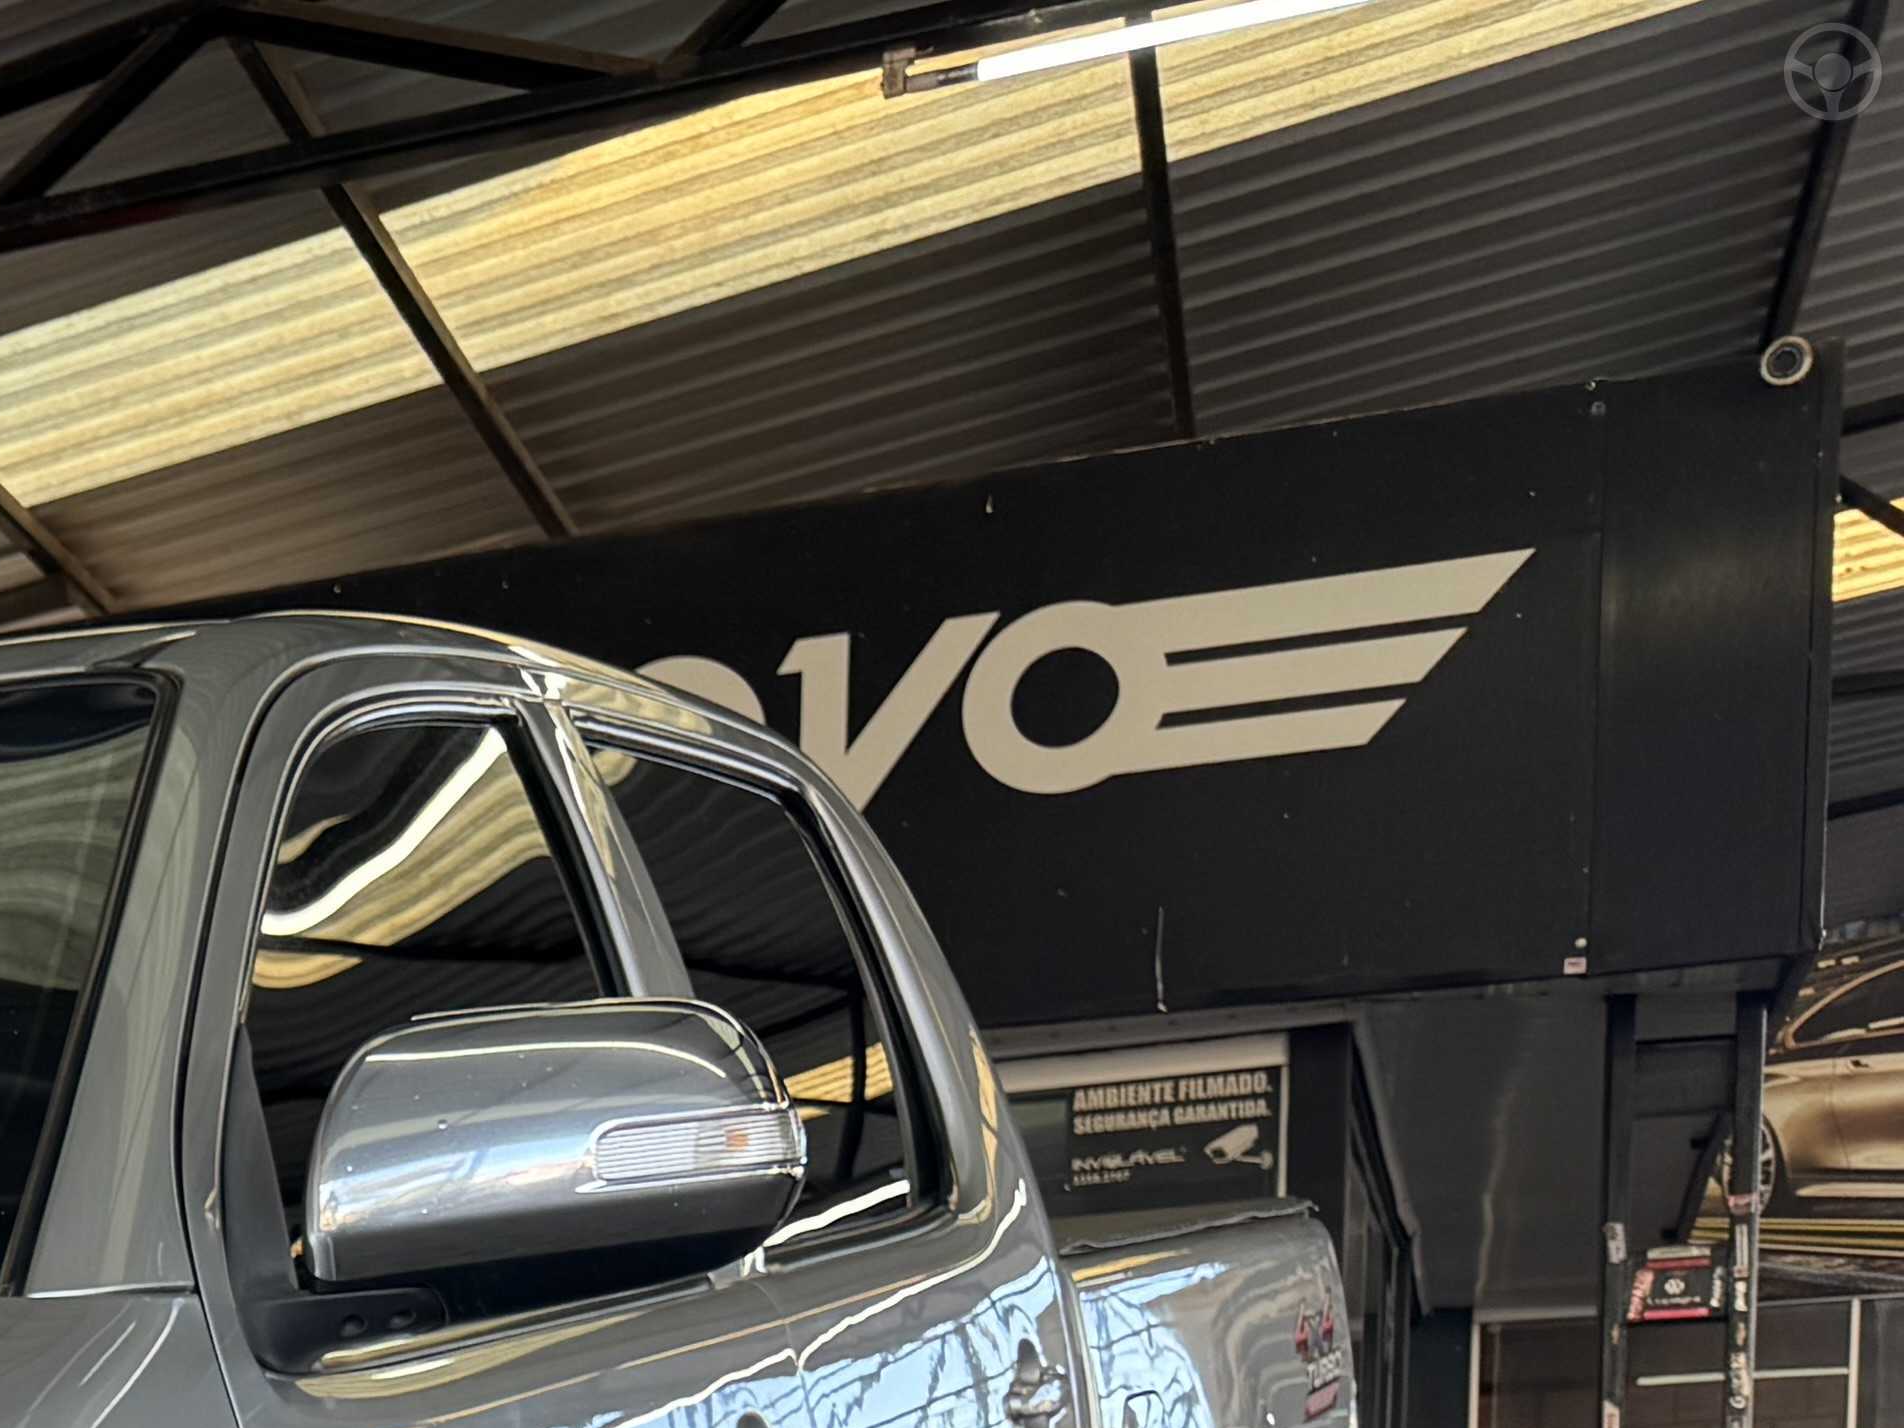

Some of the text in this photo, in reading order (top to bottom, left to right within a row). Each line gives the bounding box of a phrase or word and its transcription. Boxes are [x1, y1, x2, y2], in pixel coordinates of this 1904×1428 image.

[1073, 1071, 1273, 1113] AMBIENTE FILMADO.
[1073, 1098, 1272, 1136] SEGURANÇA GARANTIDA.
